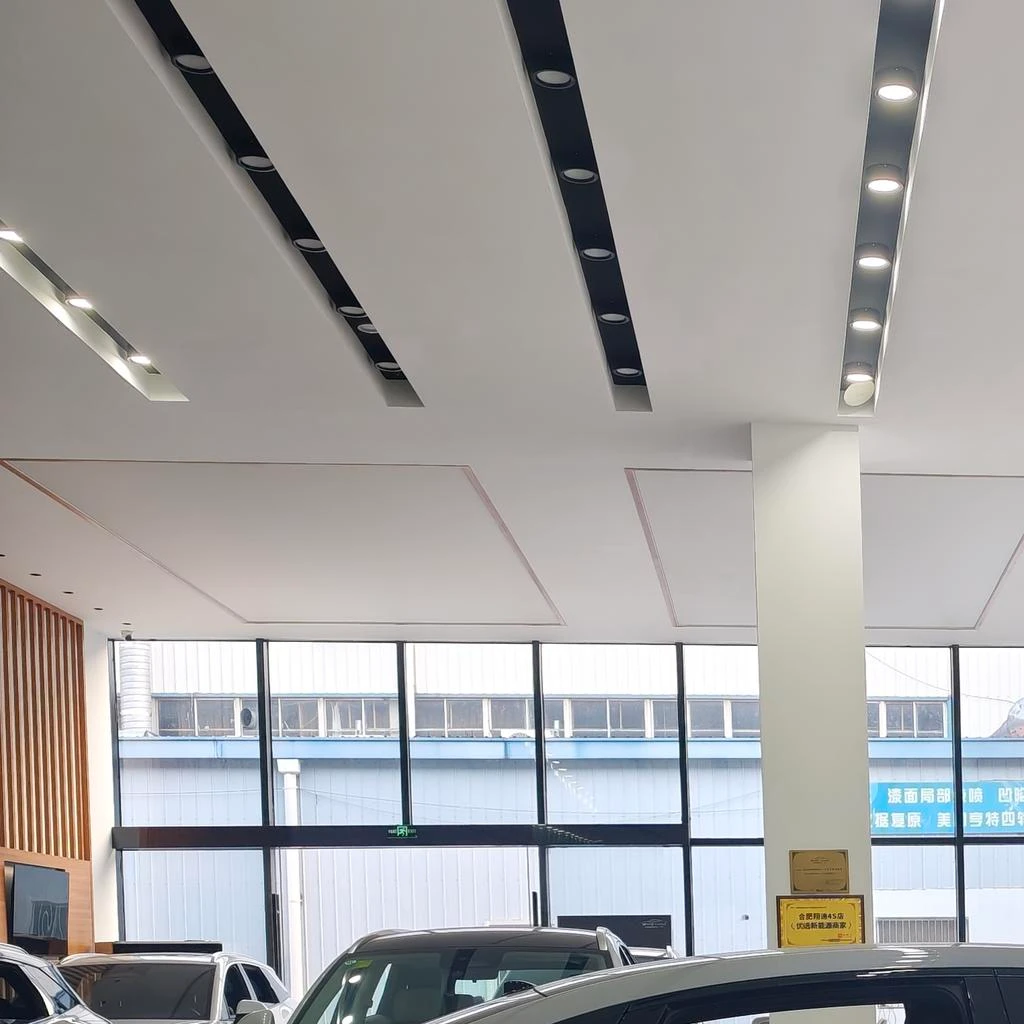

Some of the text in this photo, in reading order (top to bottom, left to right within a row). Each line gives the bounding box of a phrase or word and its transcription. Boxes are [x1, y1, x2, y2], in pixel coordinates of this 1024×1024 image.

[887, 787, 983, 804] 漆面局部喷
[872, 811, 922, 828] 据复原
